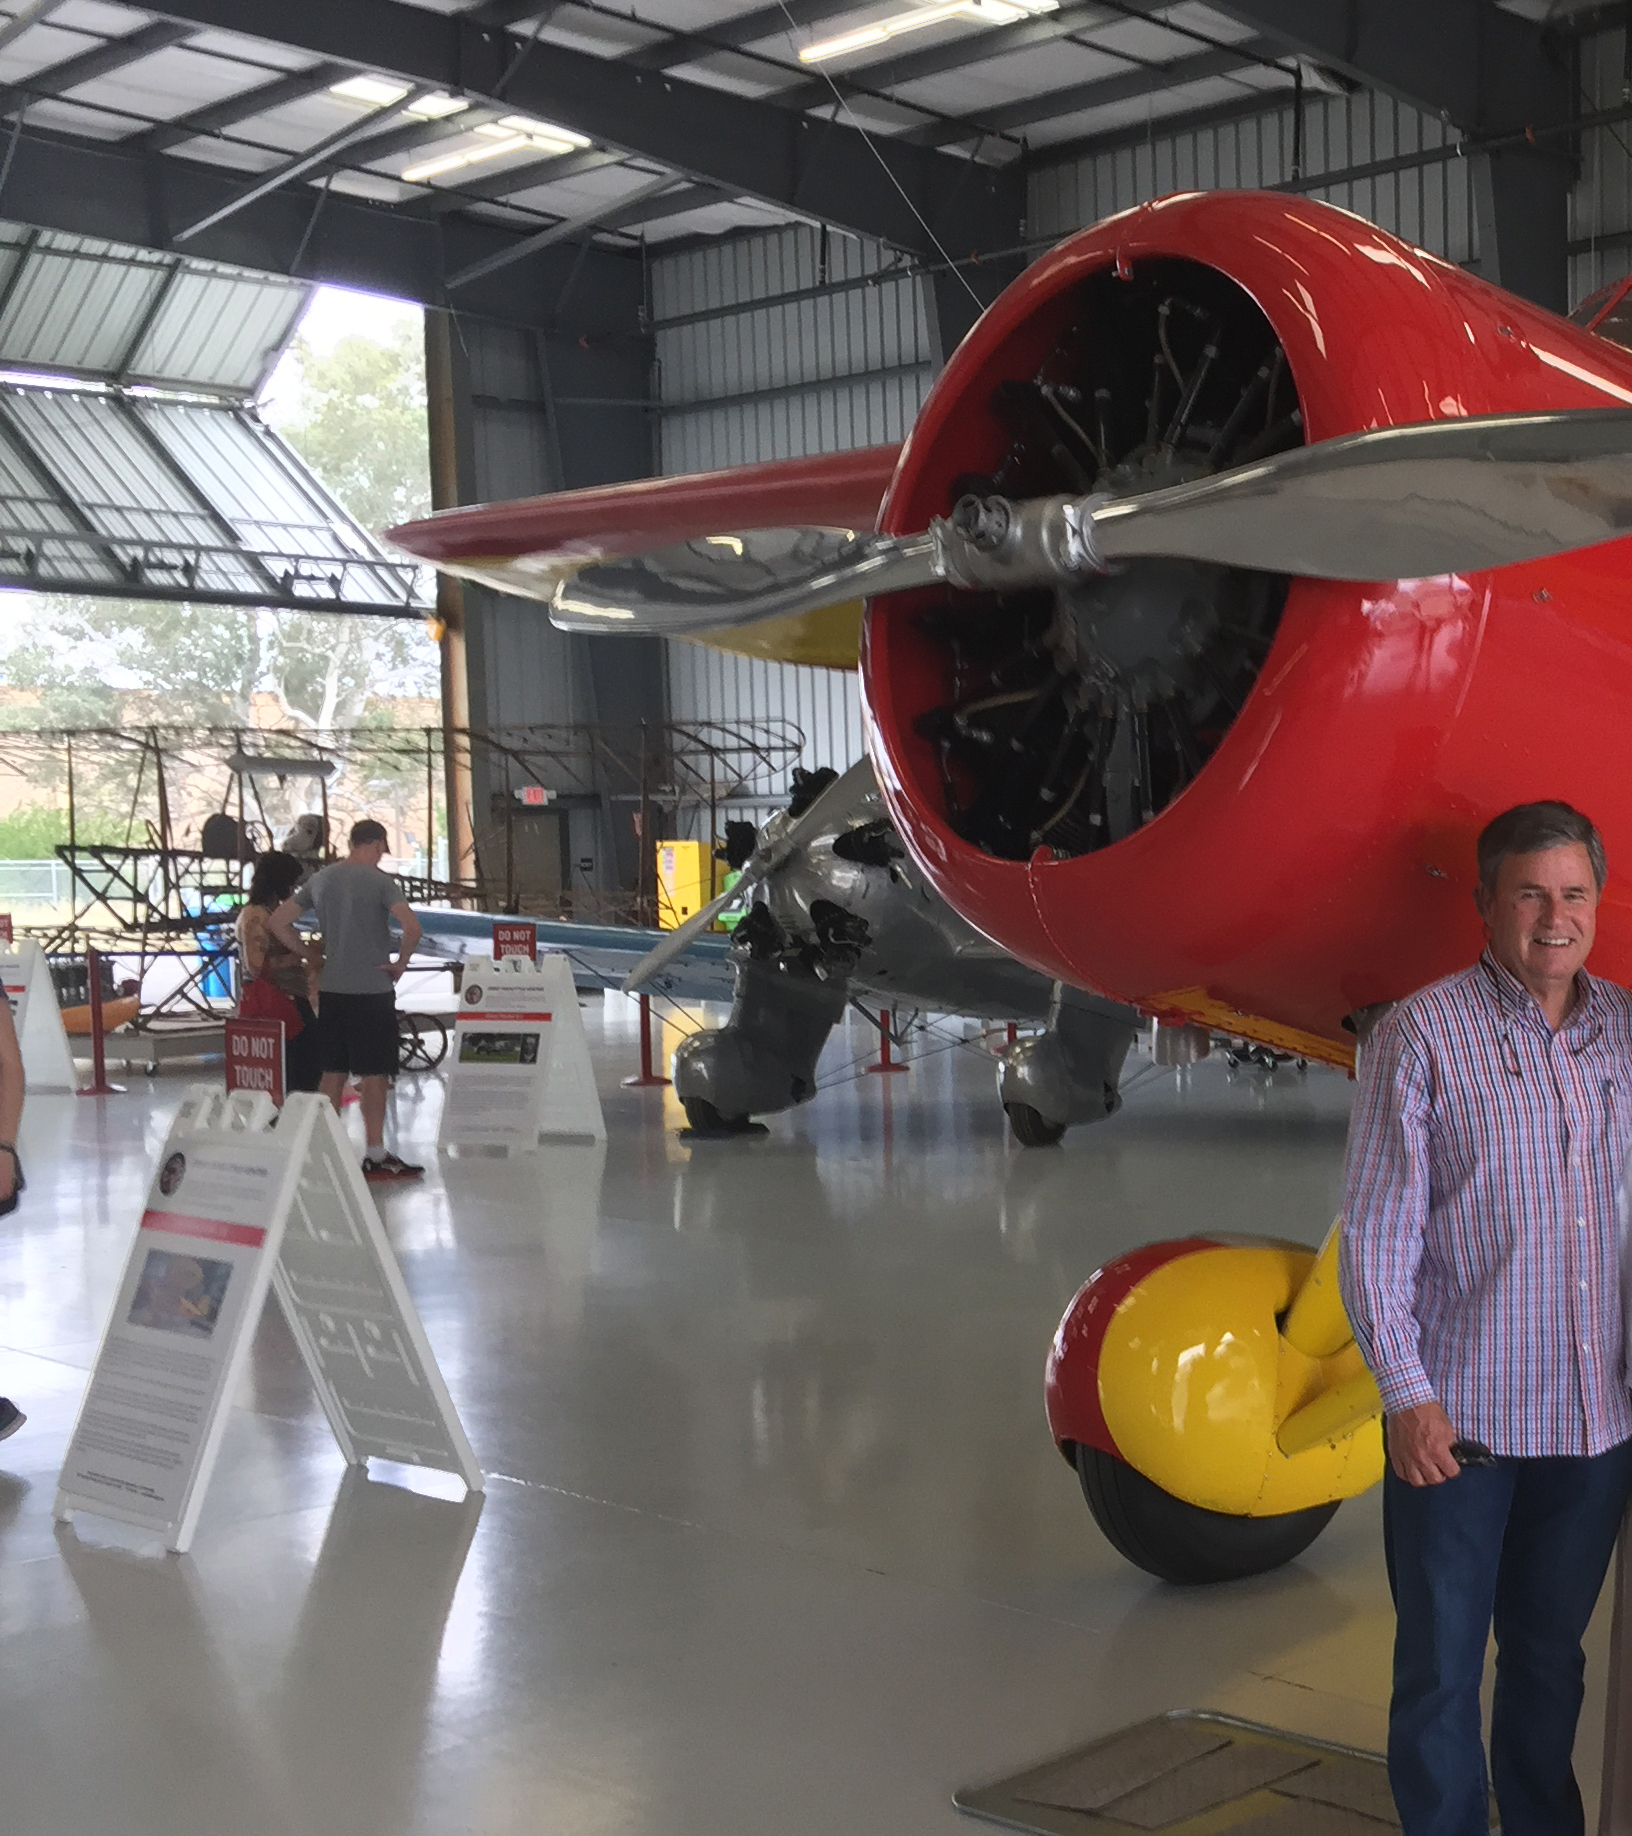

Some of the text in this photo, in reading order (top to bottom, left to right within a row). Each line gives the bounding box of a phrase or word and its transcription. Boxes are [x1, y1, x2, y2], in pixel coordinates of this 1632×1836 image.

[498, 930, 532, 941] DO NOT
[500, 944, 530, 955] TOUCH
[232, 1034, 275, 1059] DO NOT
[233, 1064, 274, 1090] TOUCH
